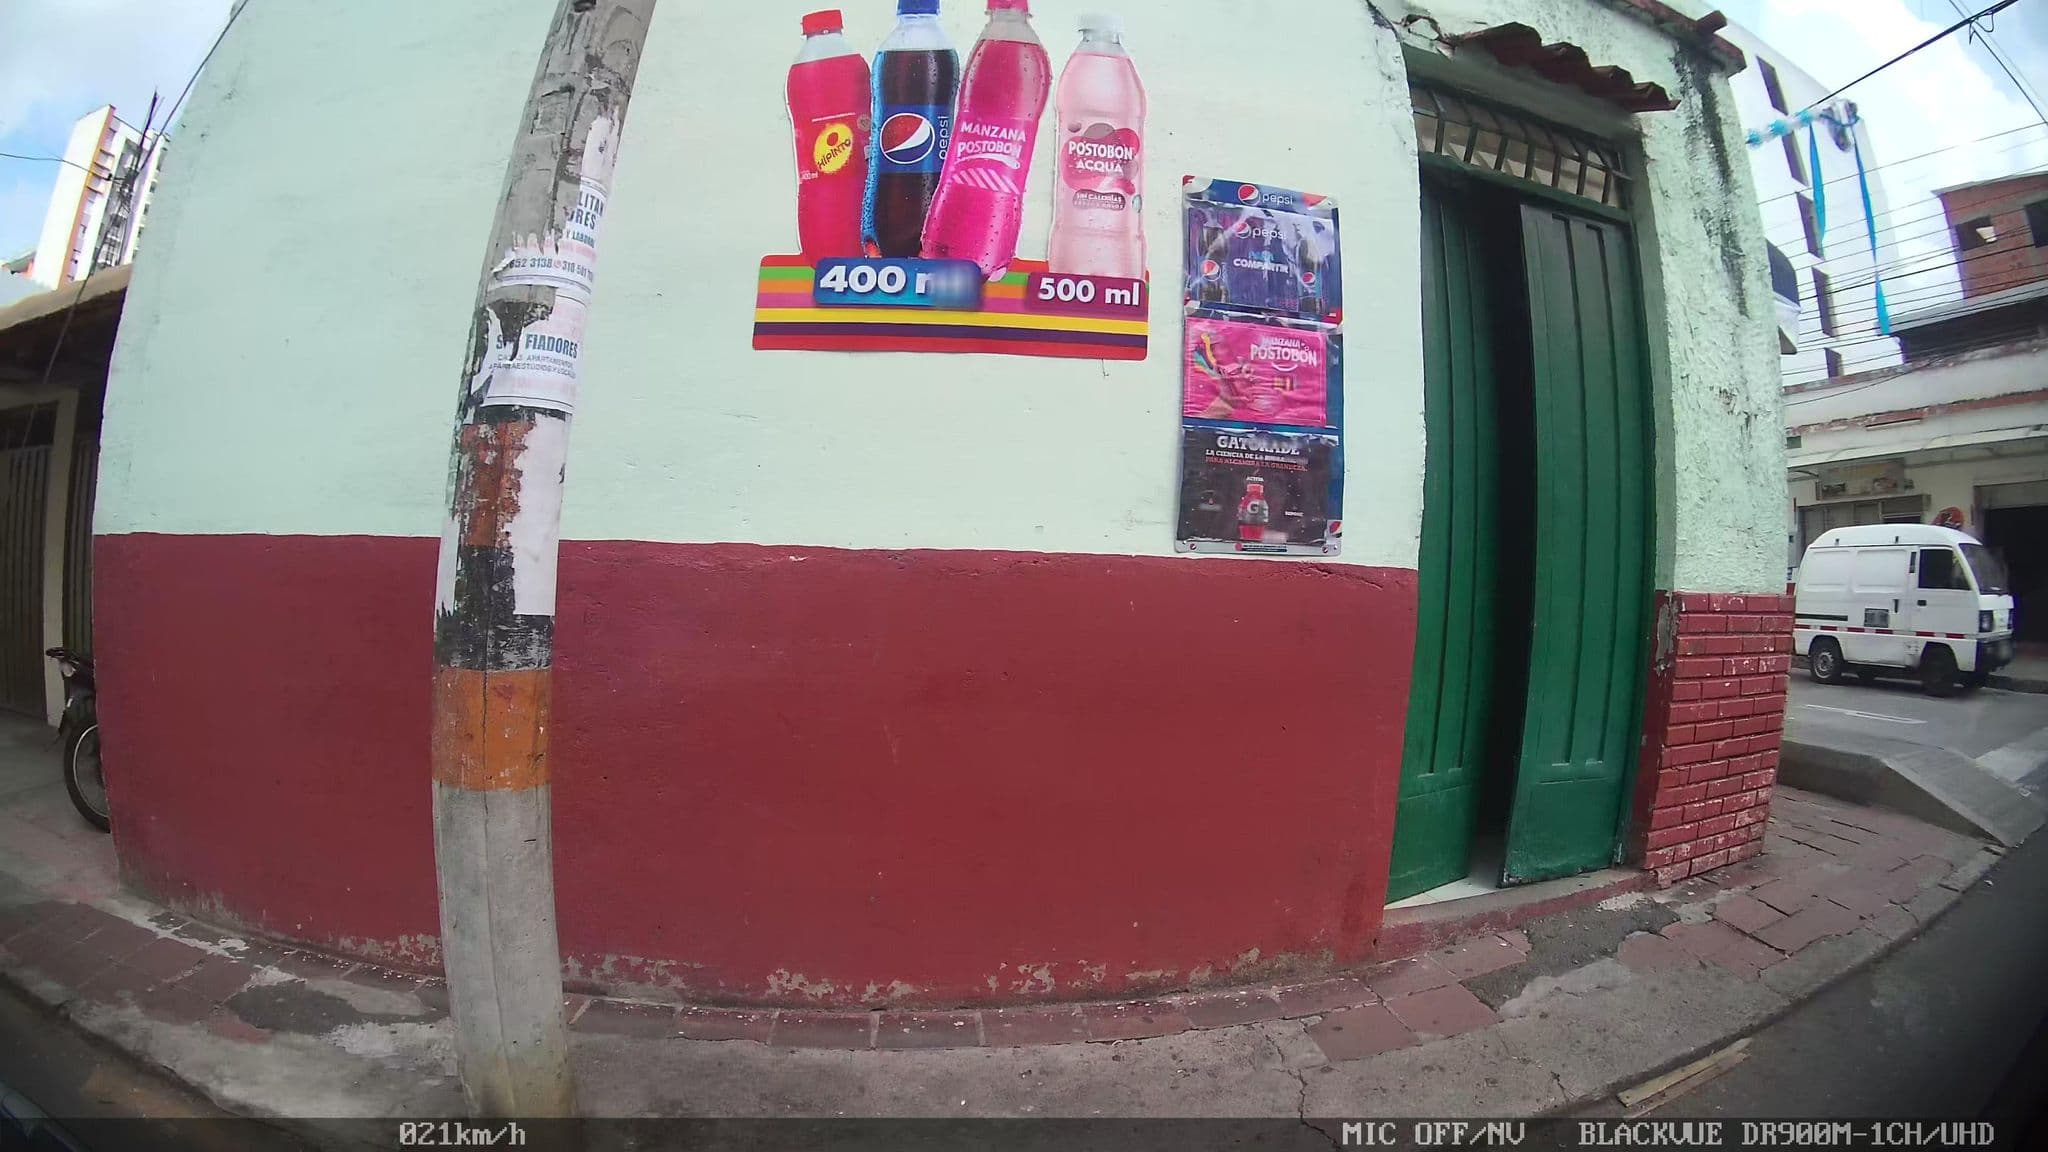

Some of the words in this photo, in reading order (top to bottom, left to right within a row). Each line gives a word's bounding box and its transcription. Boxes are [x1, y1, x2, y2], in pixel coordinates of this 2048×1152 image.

[960, 121, 1026, 142] MANZANA
[1076, 159, 1123, 173] ACQUA
[1262, 194, 1293, 205] pepsi
[1252, 227, 1286, 240] pepsi
[1233, 257, 1289, 274] COMPARTIR
[819, 265, 907, 293] 400
[1037, 277, 1096, 304] 500
[1105, 282, 1140, 307] ml
[525, 333, 578, 359] FIADORES
